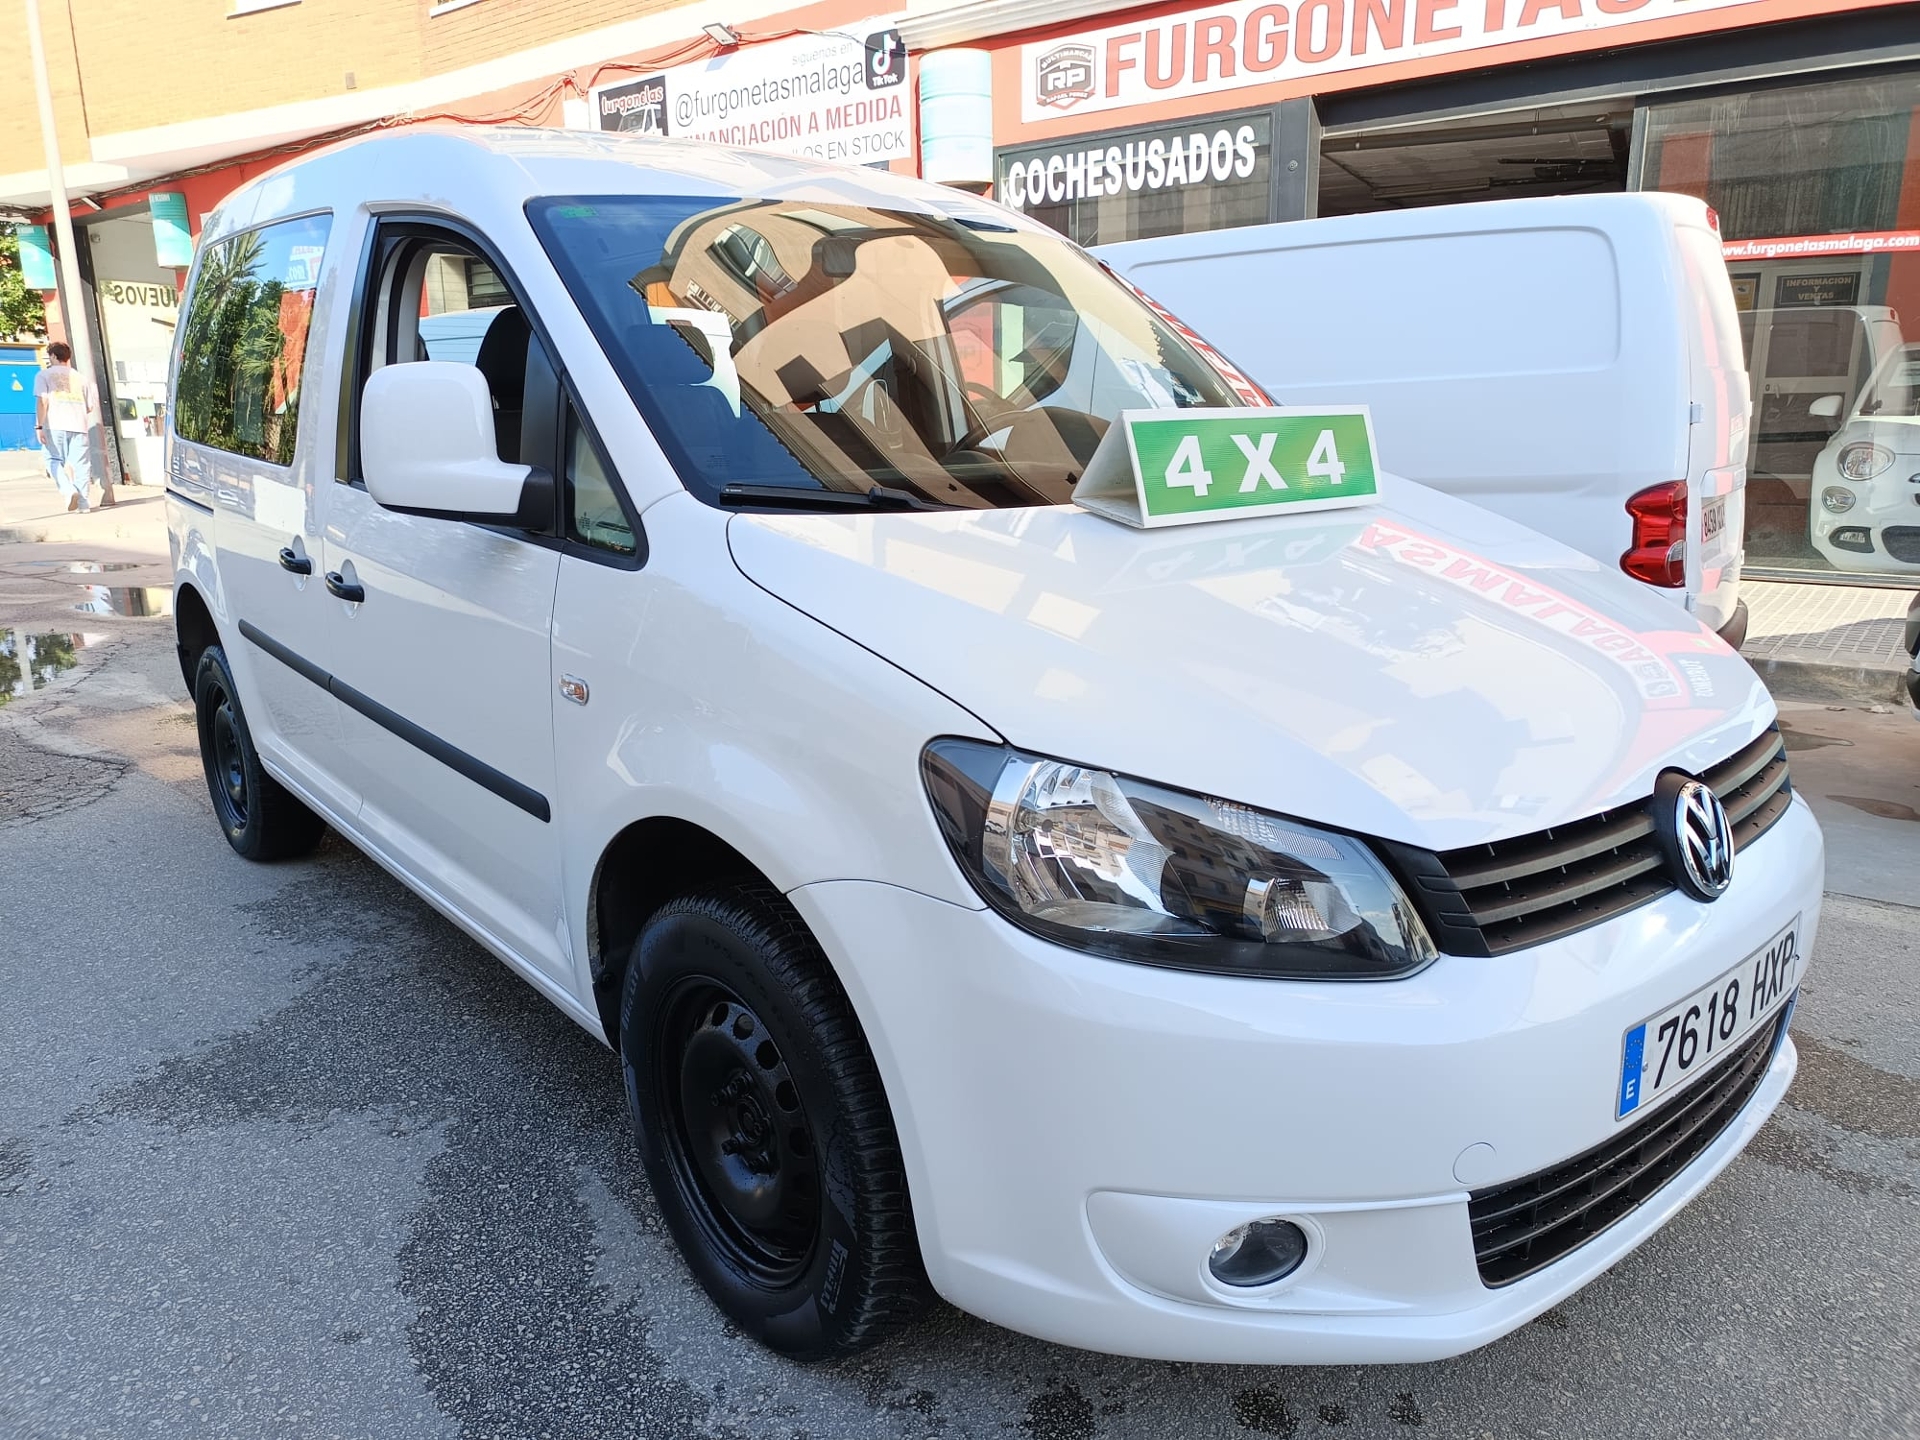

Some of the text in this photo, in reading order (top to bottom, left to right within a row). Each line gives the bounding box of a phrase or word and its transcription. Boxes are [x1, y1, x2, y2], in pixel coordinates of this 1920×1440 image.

[840, 42, 853, 55] en
[1105, 0, 1651, 98] FURGONE
[872, 74, 899, 87] TikTok
[1047, 67, 1086, 91] RP
[675, 61, 864, 127] @furgonetasmalaga
[682, 94, 903, 146] NCIACIÓN A MEDIDA
[827, 140, 848, 160] EN
[852, 130, 906, 156] STOCK
[1797, 291, 1834, 301] VENTAS
[1813, 285, 1820, 293] Y
[1164, 429, 1346, 497] 4 X 4
[1653, 930, 1796, 1090] 7618 HXP
[1625, 1078, 1636, 1100] E
